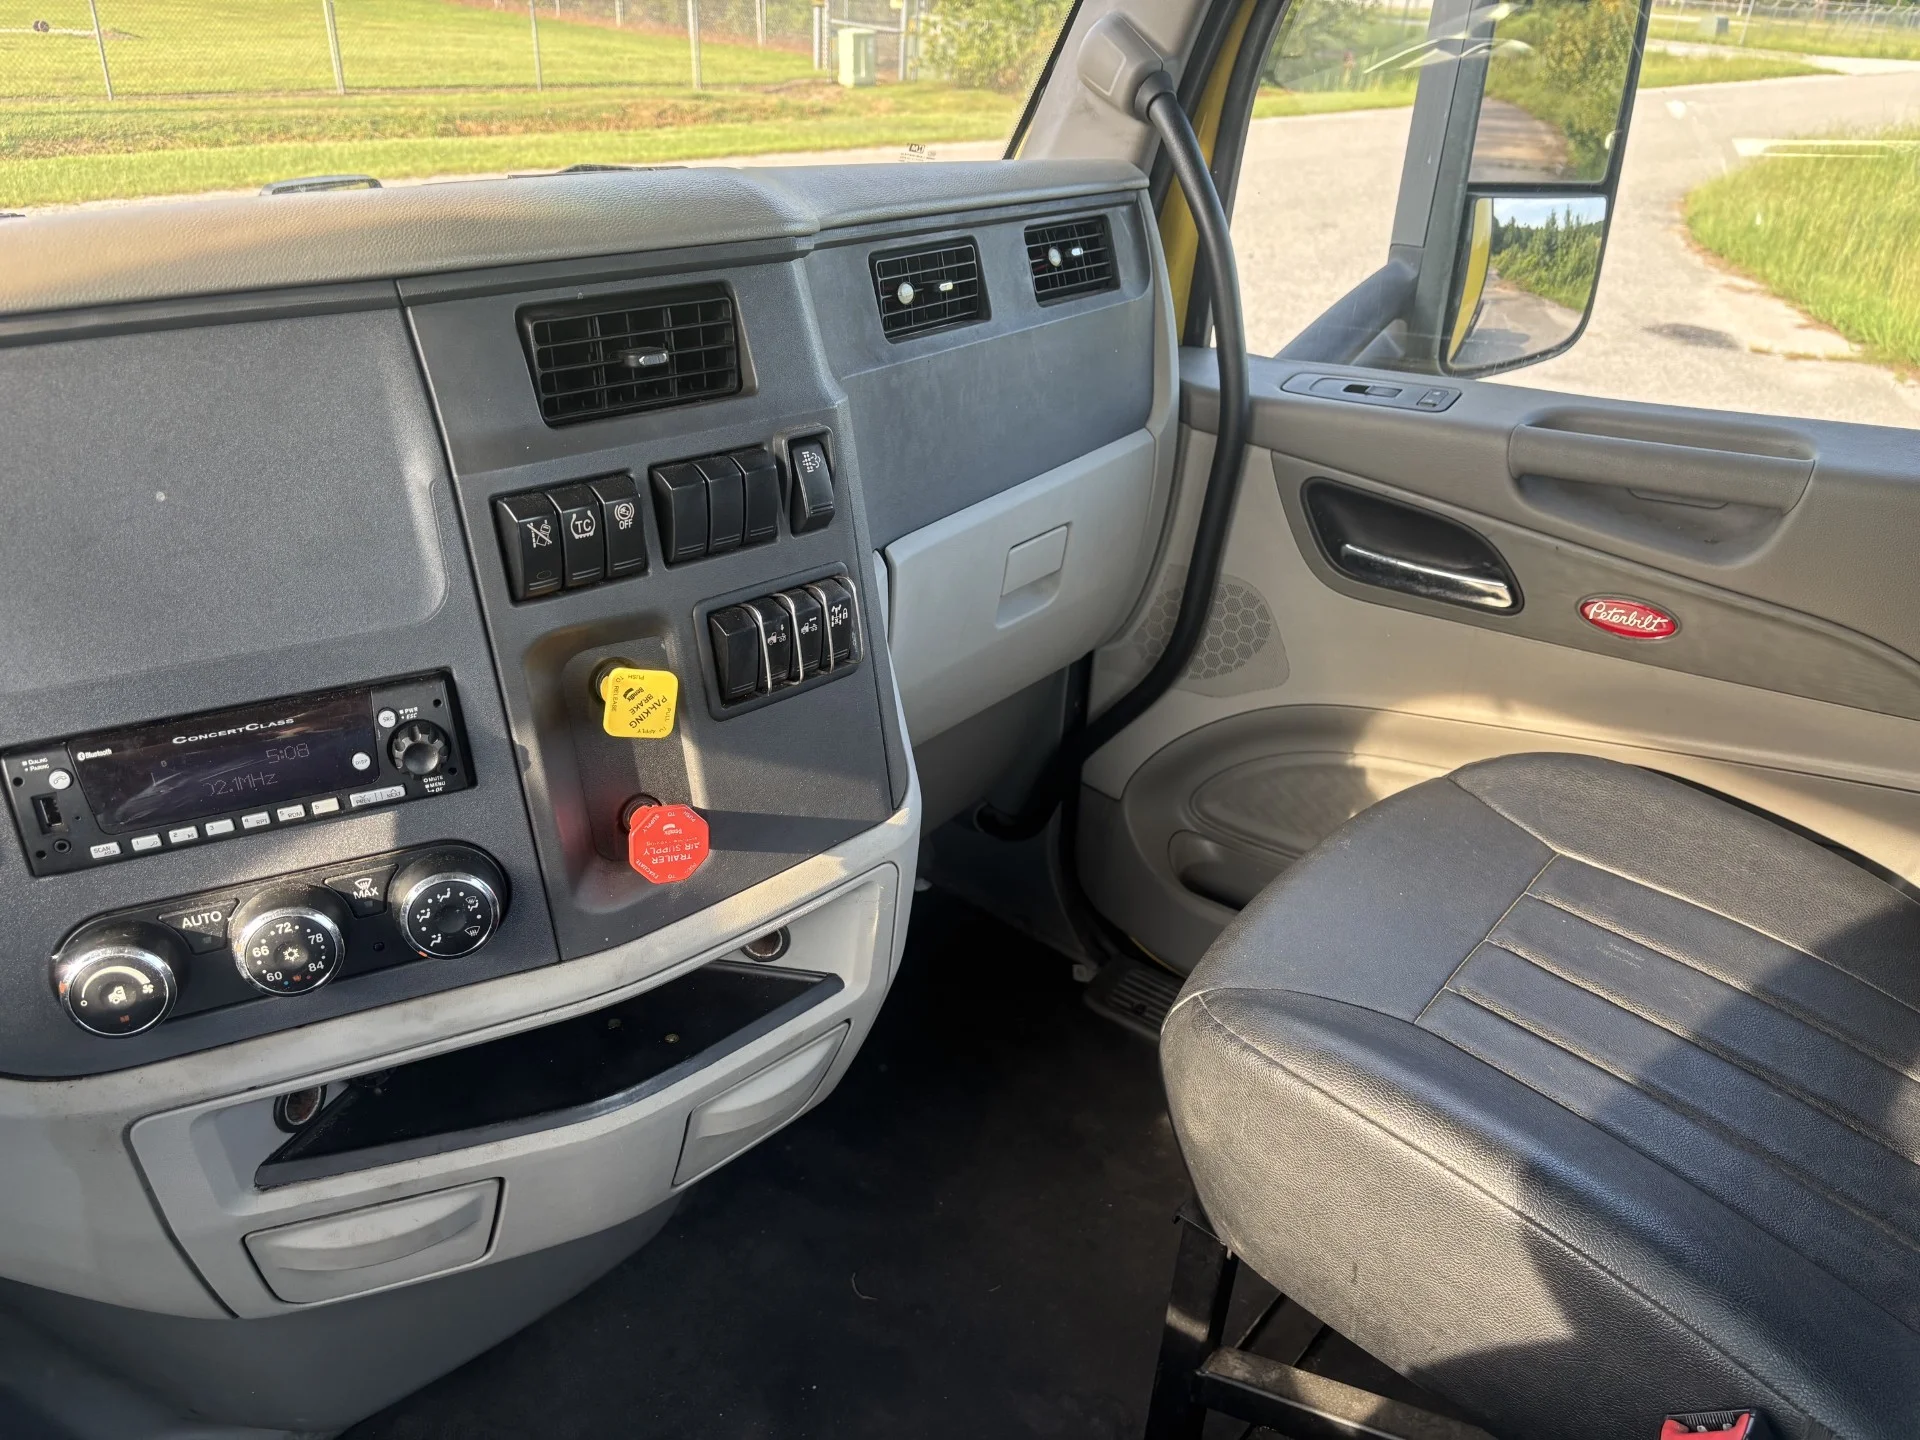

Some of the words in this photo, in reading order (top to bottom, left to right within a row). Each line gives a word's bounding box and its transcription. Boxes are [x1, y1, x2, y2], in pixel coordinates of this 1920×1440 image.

[575, 519, 591, 533] TC
[619, 519, 633, 530] OFF
[1589, 602, 1668, 631] Peterbilt
[611, 685, 620, 712] RELEASE
[629, 693, 654, 715] BRAKE
[85, 748, 113, 759] Bluetooth
[266, 742, 310, 764] 5:08
[643, 813, 660, 833] SUPPLY
[93, 845, 111, 854] SCAN
[643, 844, 682, 857] SUPPLY
[651, 853, 692, 866] TRAILER
[635, 858, 660, 880] EVACUATE
[353, 886, 379, 900] MAX
[182, 910, 222, 929] AUTO
[276, 922, 293, 934] 72
[308, 933, 324, 945] 78
[252, 945, 270, 958] 66
[308, 961, 324, 972] 84
[266, 971, 283, 982] 60
